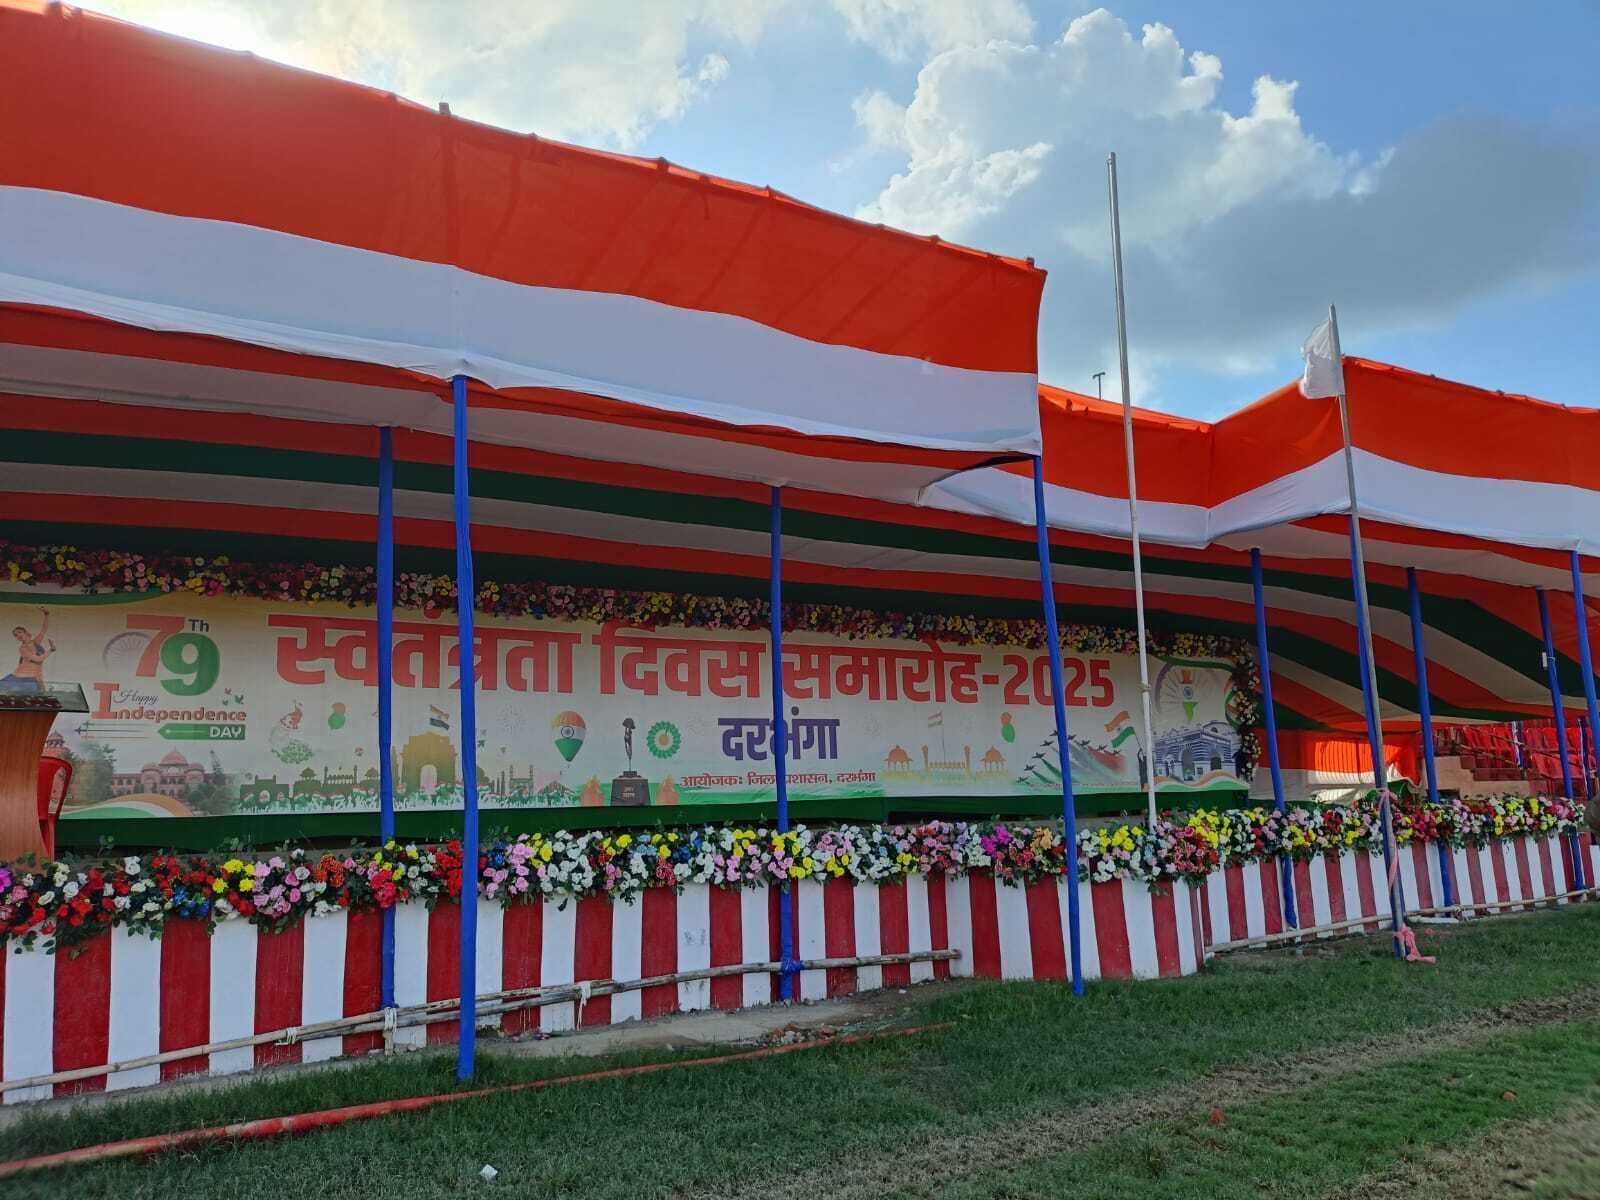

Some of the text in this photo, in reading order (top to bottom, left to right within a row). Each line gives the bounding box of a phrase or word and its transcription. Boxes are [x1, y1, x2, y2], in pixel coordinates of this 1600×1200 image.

[267, 607, 582, 693] स्वतंत्रता
[591, 617, 768, 698] दिवस
[91, 682, 247, 723] Independence
[112, 689, 159, 706] Happy
[208, 726, 242, 738] DAY
[717, 706, 841, 761] दरभंगा
[747, 771, 777, 785] जिल
